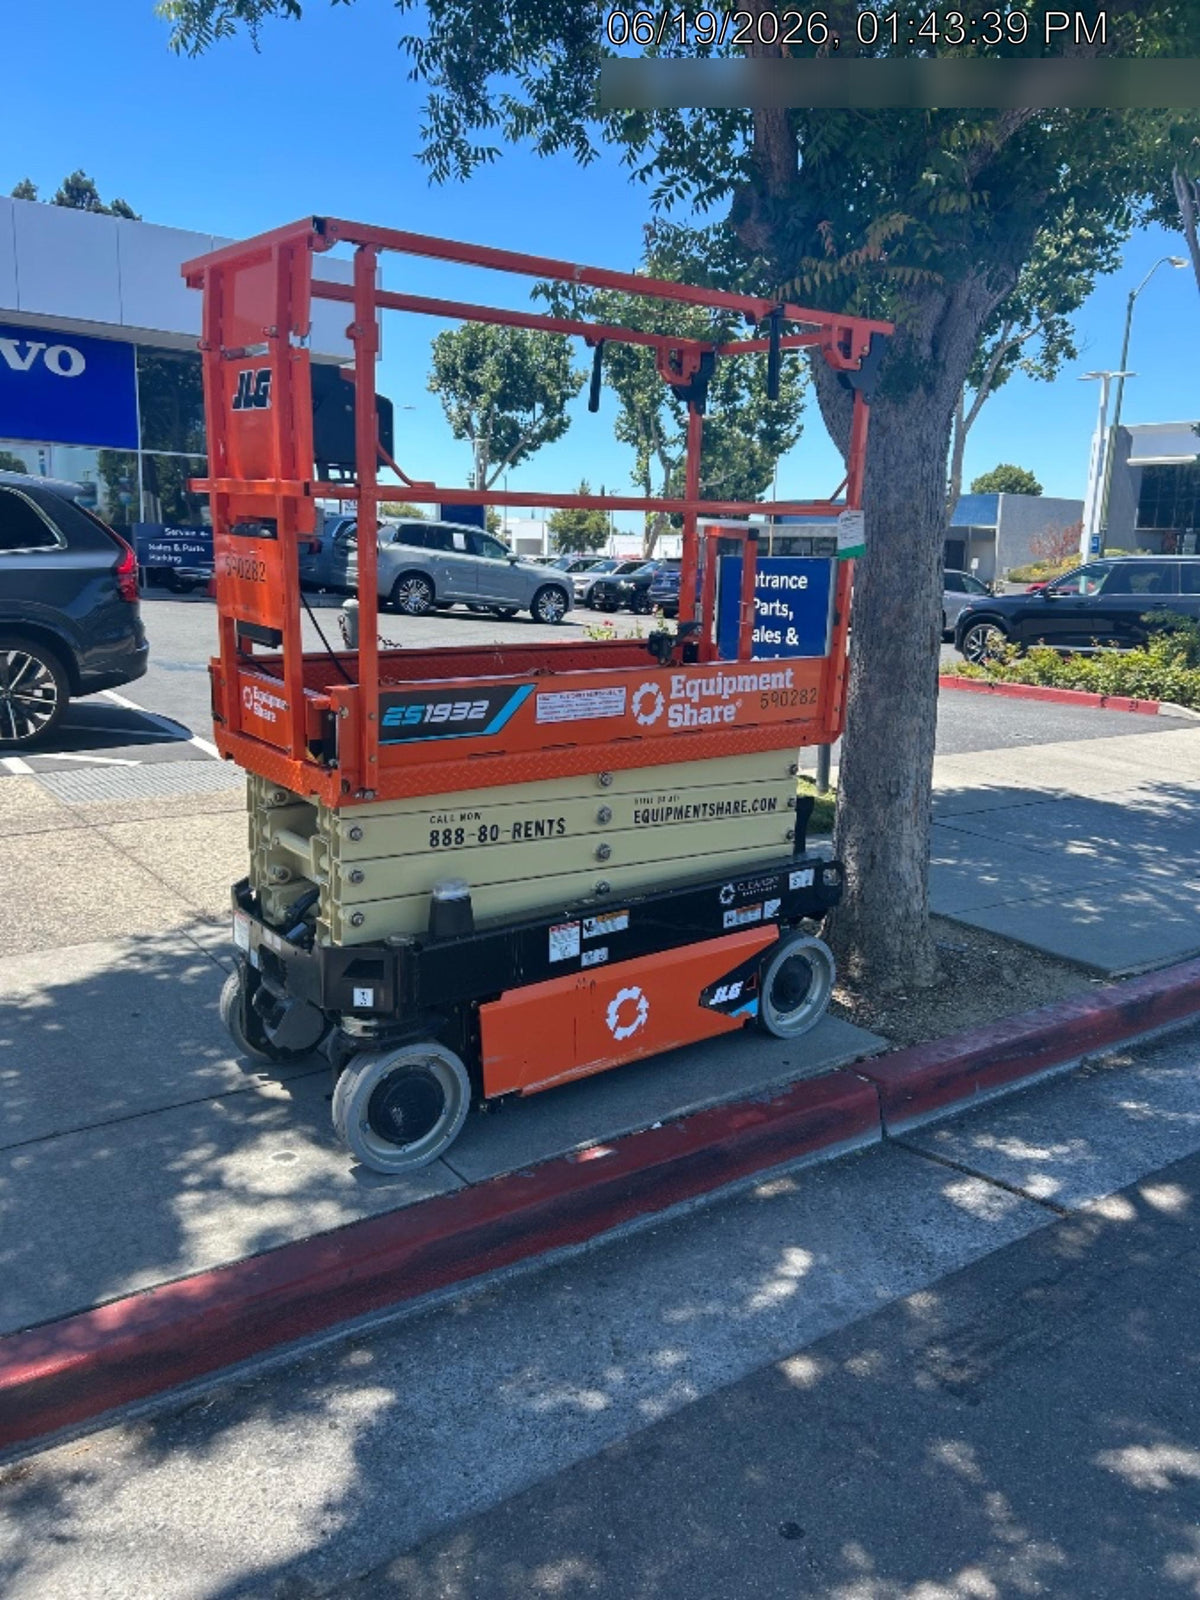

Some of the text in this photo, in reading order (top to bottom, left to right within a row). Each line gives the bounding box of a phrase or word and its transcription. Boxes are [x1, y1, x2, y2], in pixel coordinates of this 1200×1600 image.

[232, 367, 272, 411] JLG
[751, 625, 799, 646] ales &
[670, 668, 794, 703] Equipment
[760, 688, 818, 710] 590282
[381, 700, 490, 727] ES1932
[667, 704, 736, 728] Share
[429, 817, 566, 848] 888-80-RENTS
